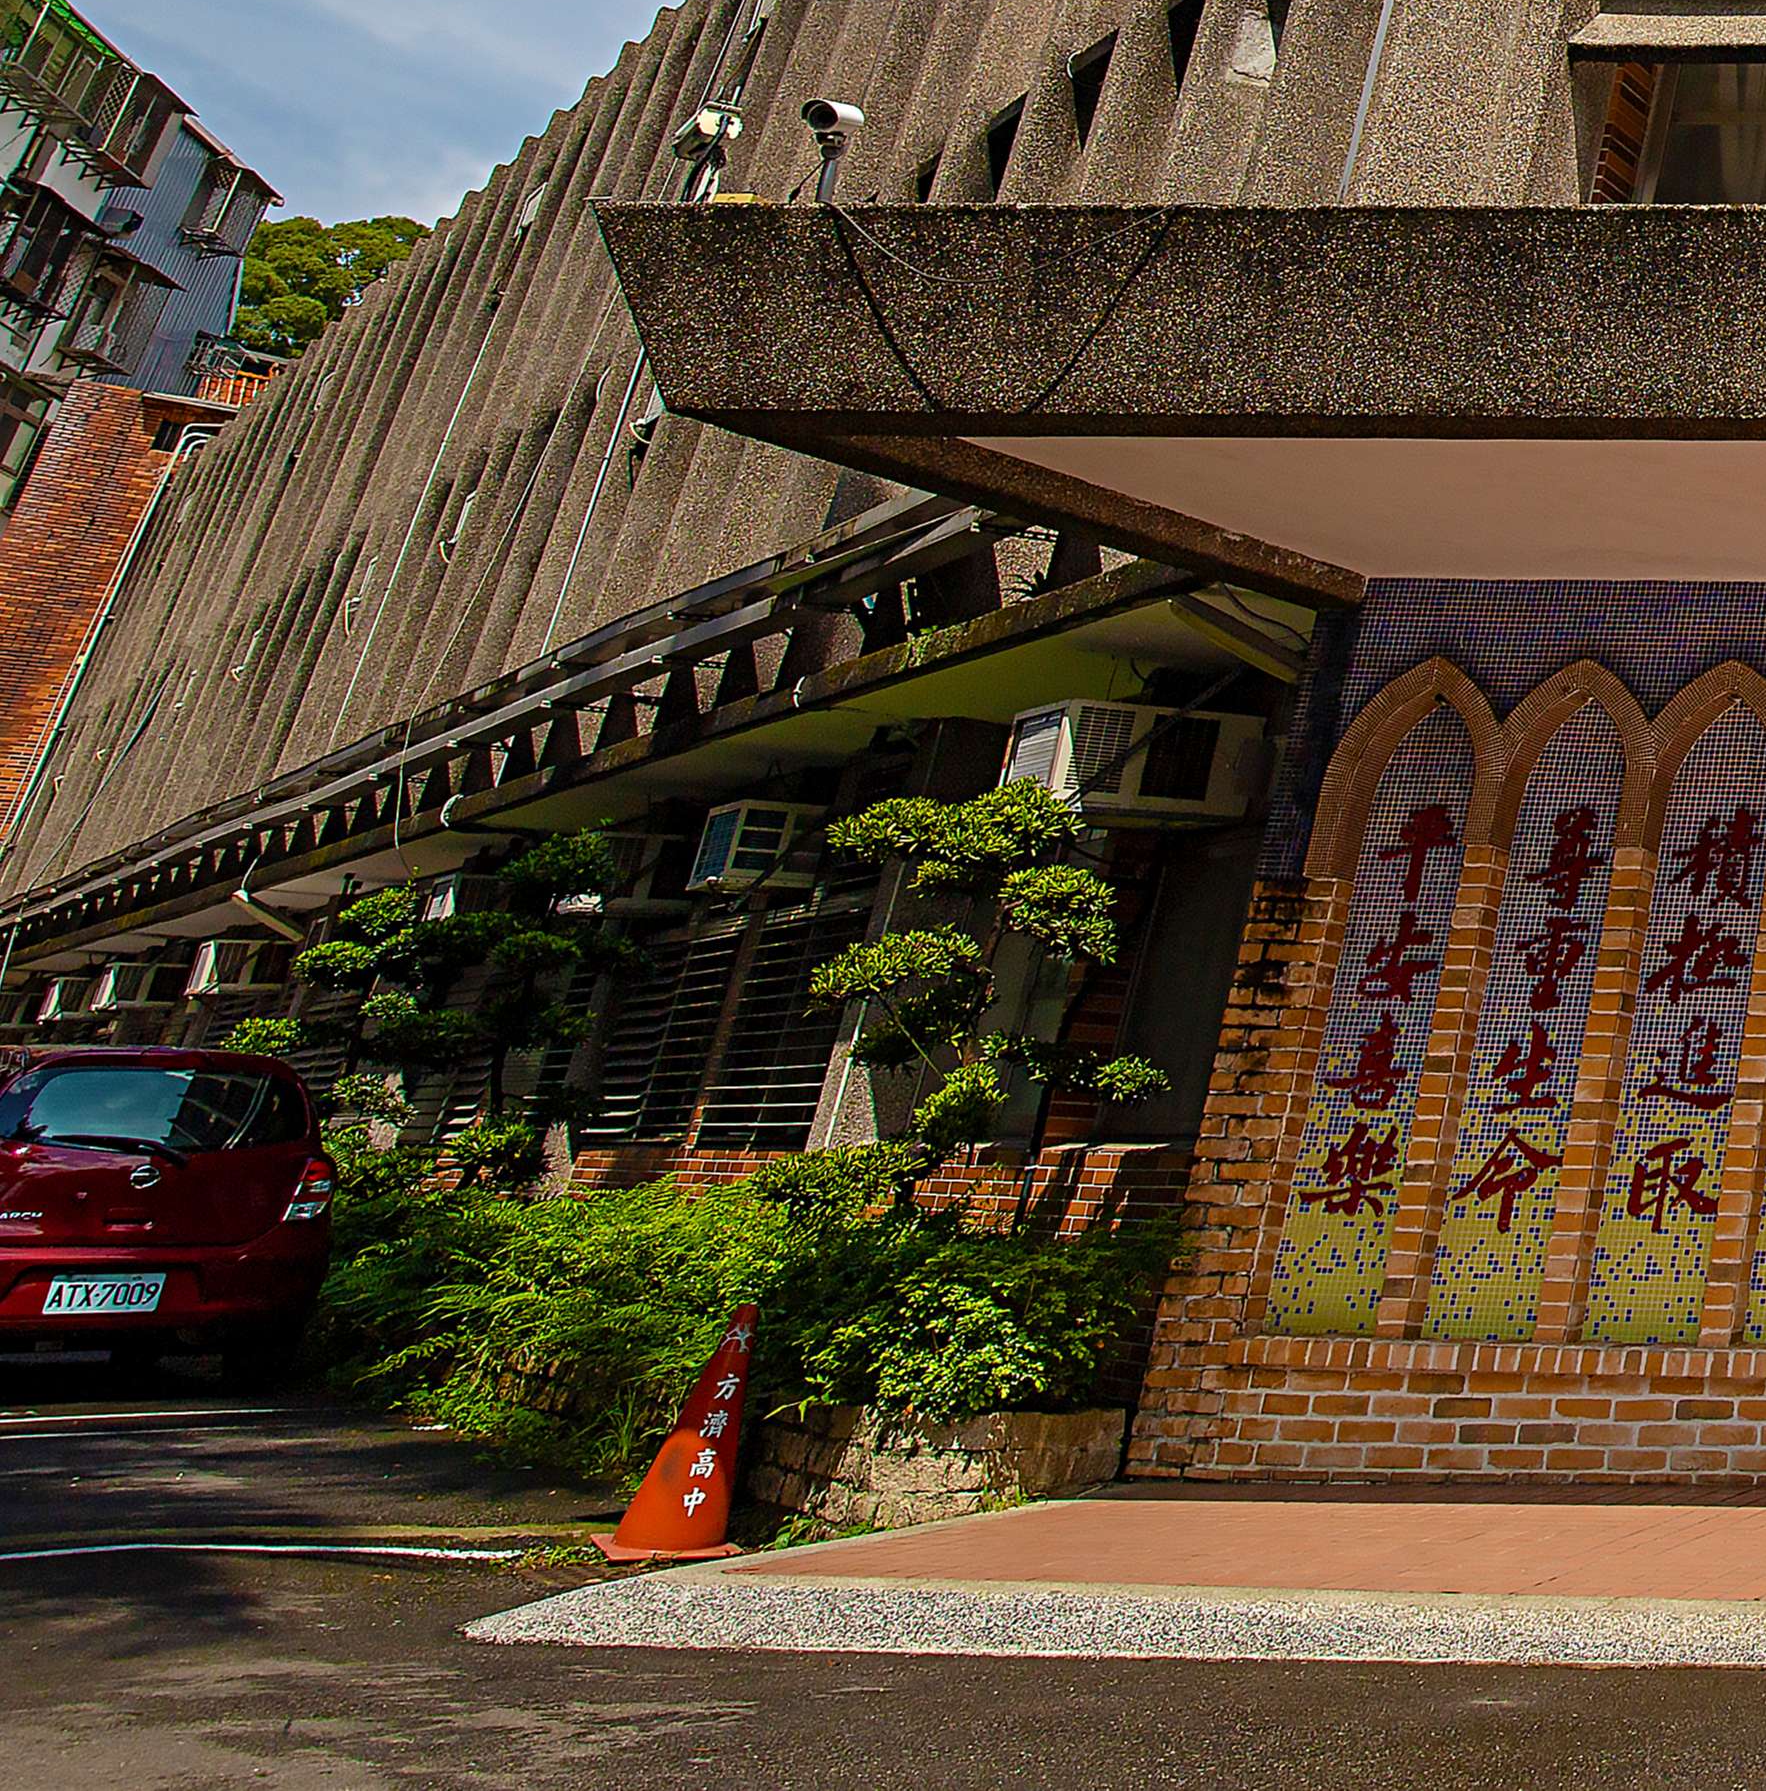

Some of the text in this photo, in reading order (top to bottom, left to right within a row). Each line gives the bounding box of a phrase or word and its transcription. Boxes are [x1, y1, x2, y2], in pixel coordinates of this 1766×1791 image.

[1300, 806, 1457, 1218] 平安喜樂
[1453, 807, 1607, 1234] 尊重生命
[1628, 807, 1763, 1232] 積極進取
[48, 1282, 160, 1308] ATX-7009
[683, 1373, 740, 1517] 方濟高中
